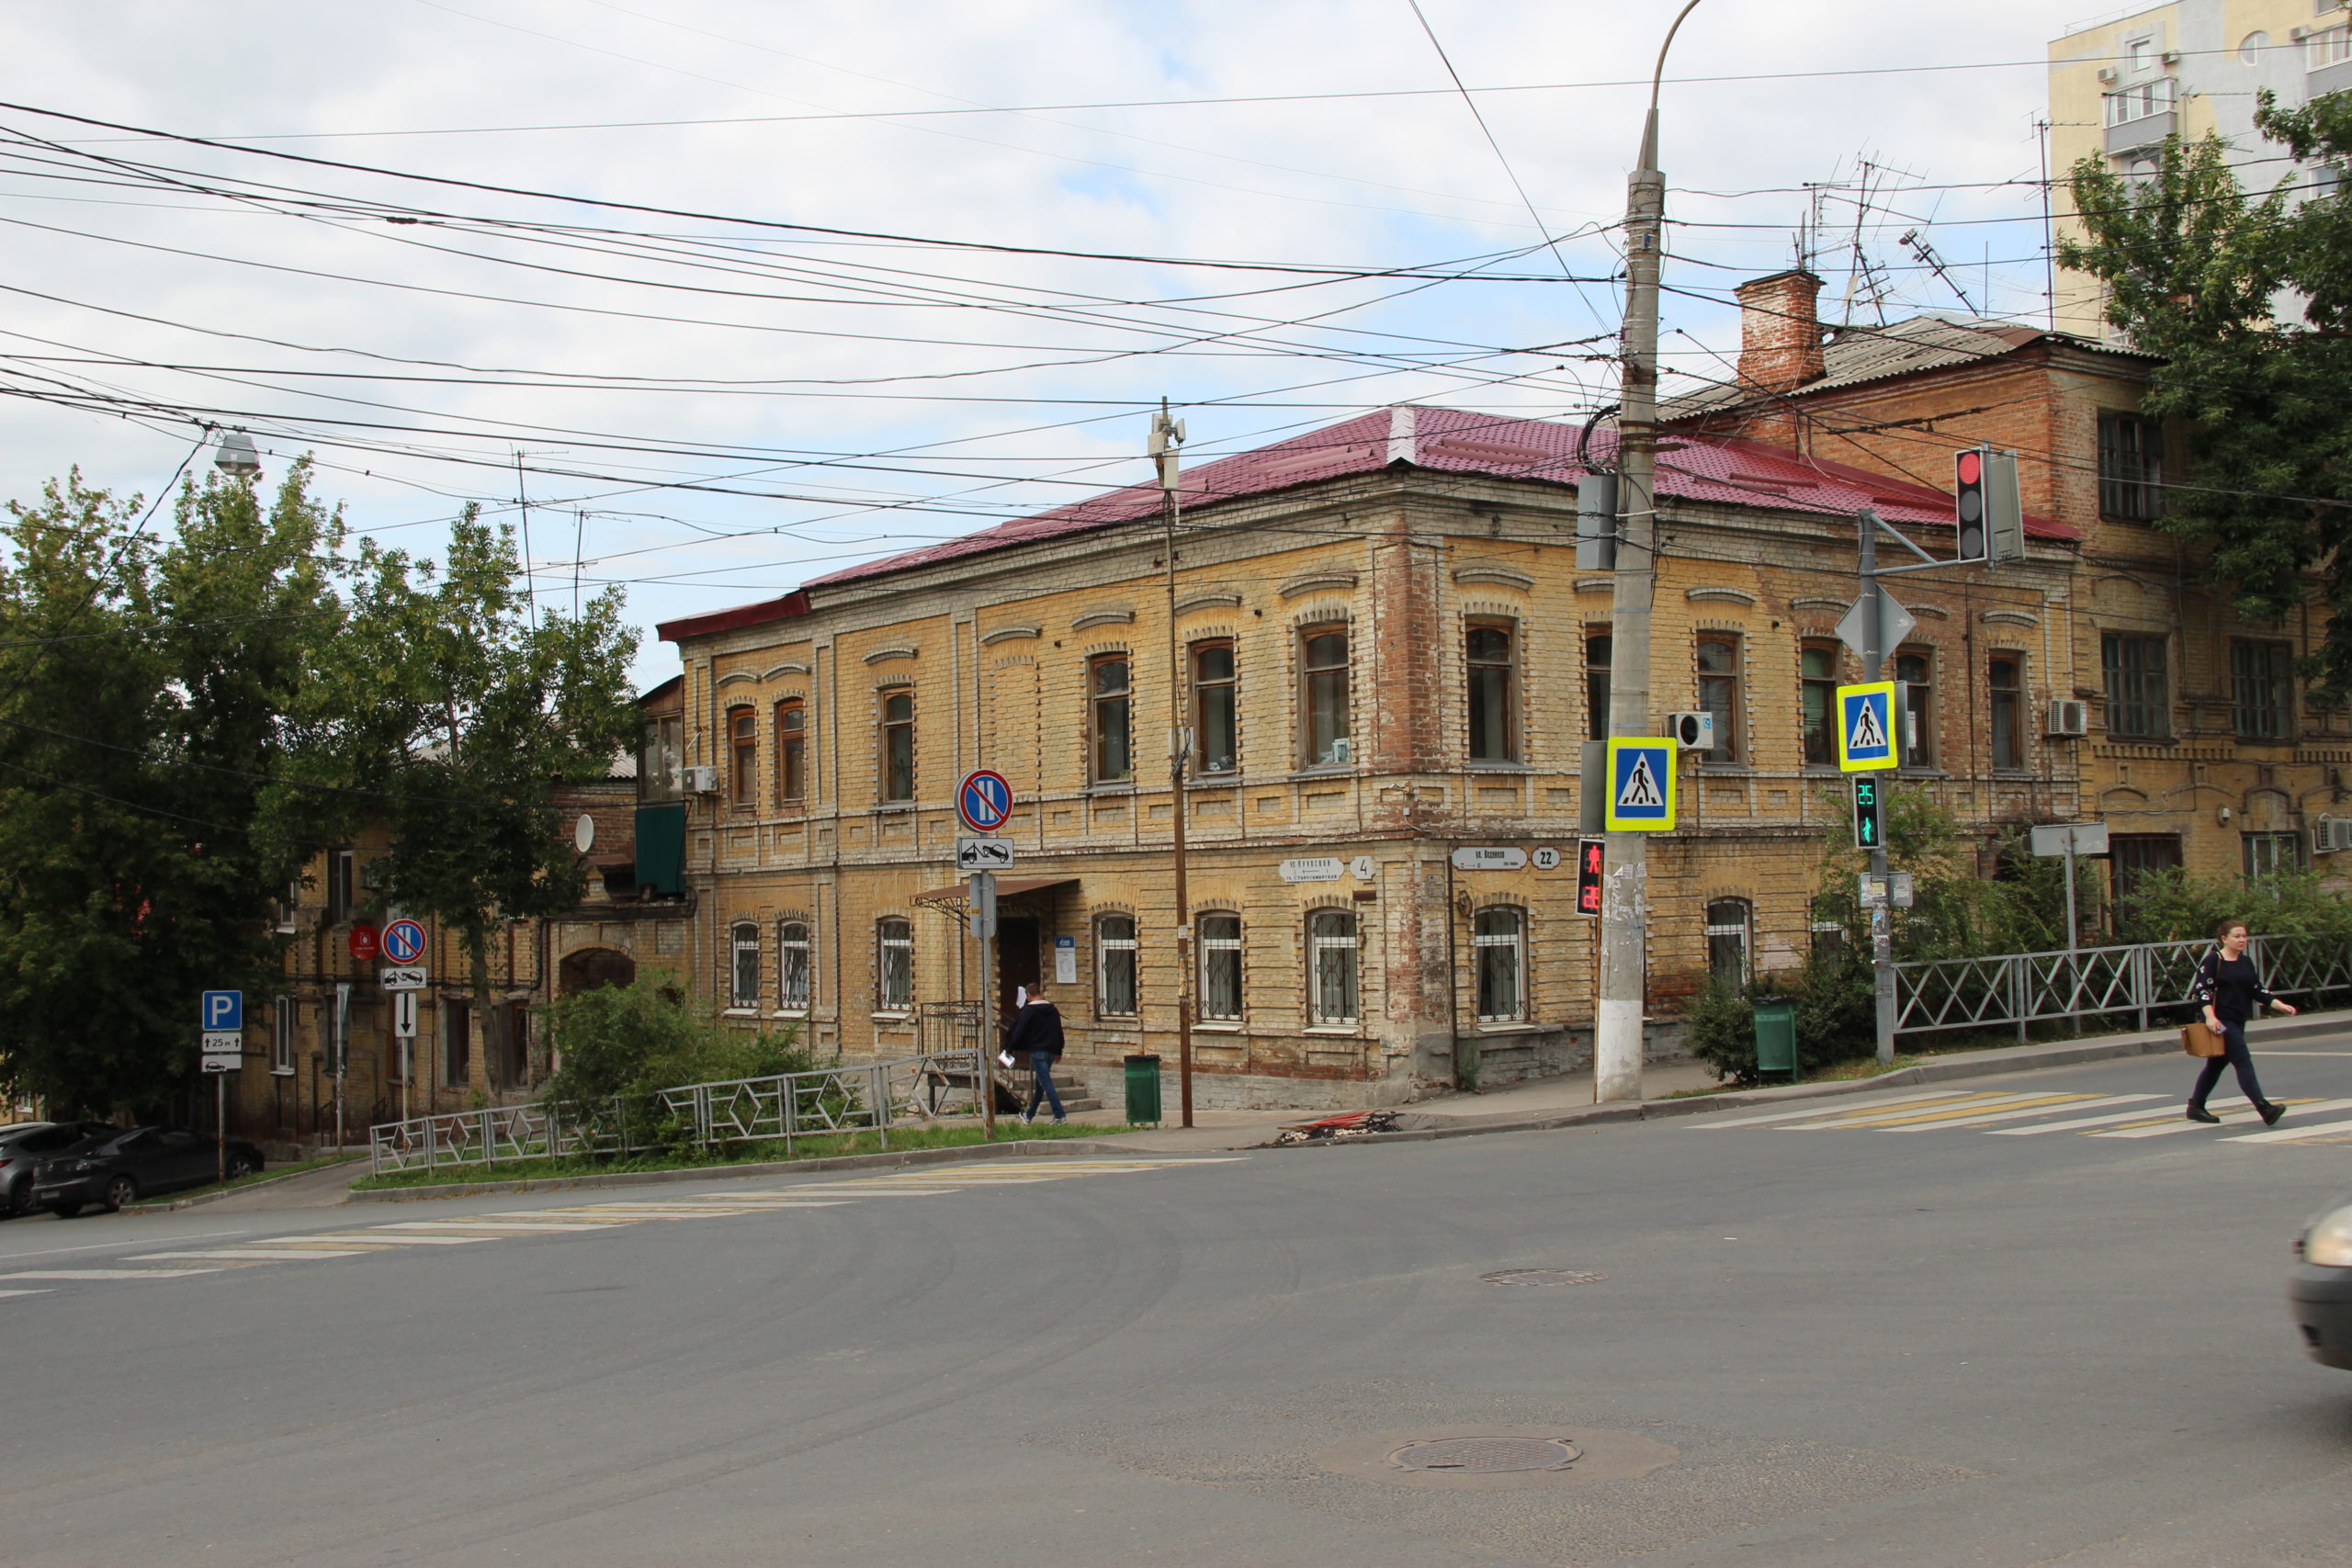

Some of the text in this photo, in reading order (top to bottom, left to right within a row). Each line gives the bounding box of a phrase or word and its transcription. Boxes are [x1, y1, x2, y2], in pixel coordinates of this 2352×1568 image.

[1858, 785, 1873, 804] 25
[1541, 852, 1552, 864] 22
[1360, 860, 1367, 875] 4
[212, 996, 232, 1025] P
[212, 1038, 223, 1047] 25
